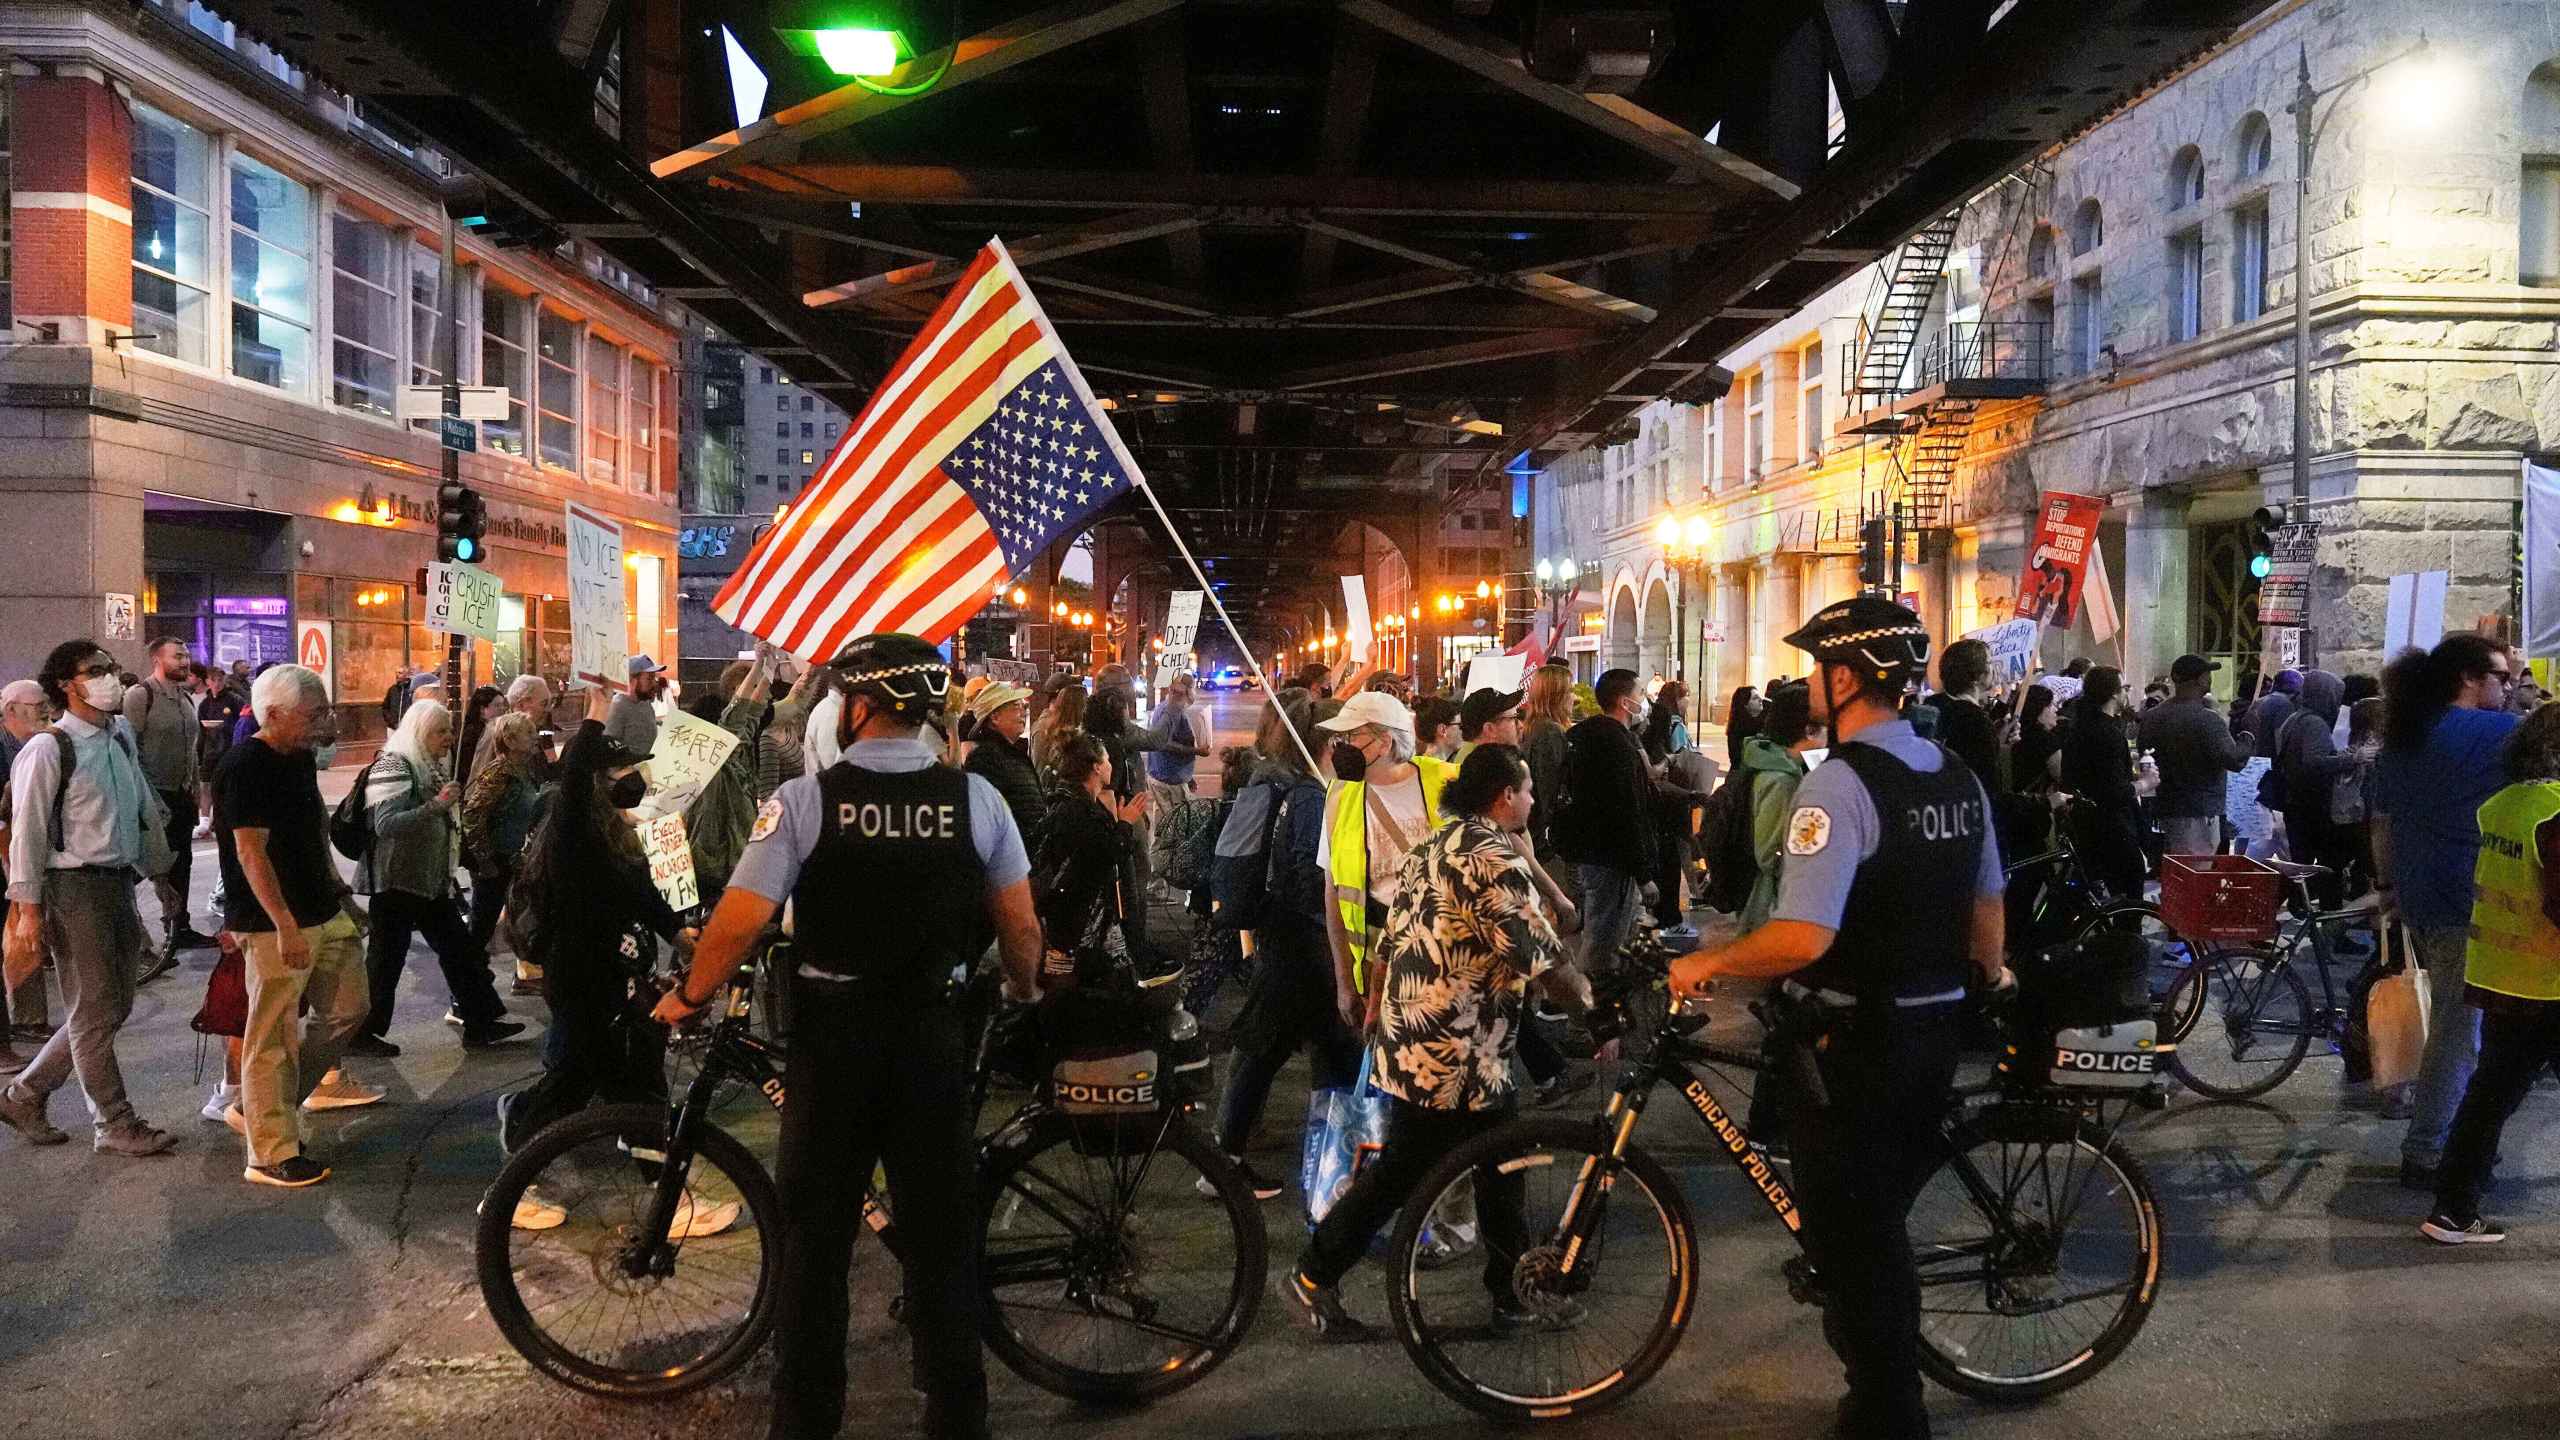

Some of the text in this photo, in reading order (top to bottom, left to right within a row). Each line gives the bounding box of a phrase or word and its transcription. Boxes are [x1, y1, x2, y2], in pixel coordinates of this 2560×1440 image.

[2047, 507, 2068, 523] STOP
[2045, 520, 2086, 538] DEPORTATIONS
[2277, 524, 2319, 542] STOP THE
[573, 519, 591, 567] NO
[597, 531, 619, 580] ICE
[2055, 534, 2084, 552] DEFEND
[2040, 544, 2080, 565] IMMIGRANTS
[456, 571, 496, 609] CRUSH
[463, 601, 486, 629] ICE
[2283, 629, 2298, 641] ONE
[2282, 643, 2298, 656] WAY
[838, 802, 955, 838] POLICE
[2057, 1050, 2154, 1072] POLICE
[1055, 1083, 1153, 1104] POLICE
[1686, 1080, 1793, 1214] CHICAGO POLICE
